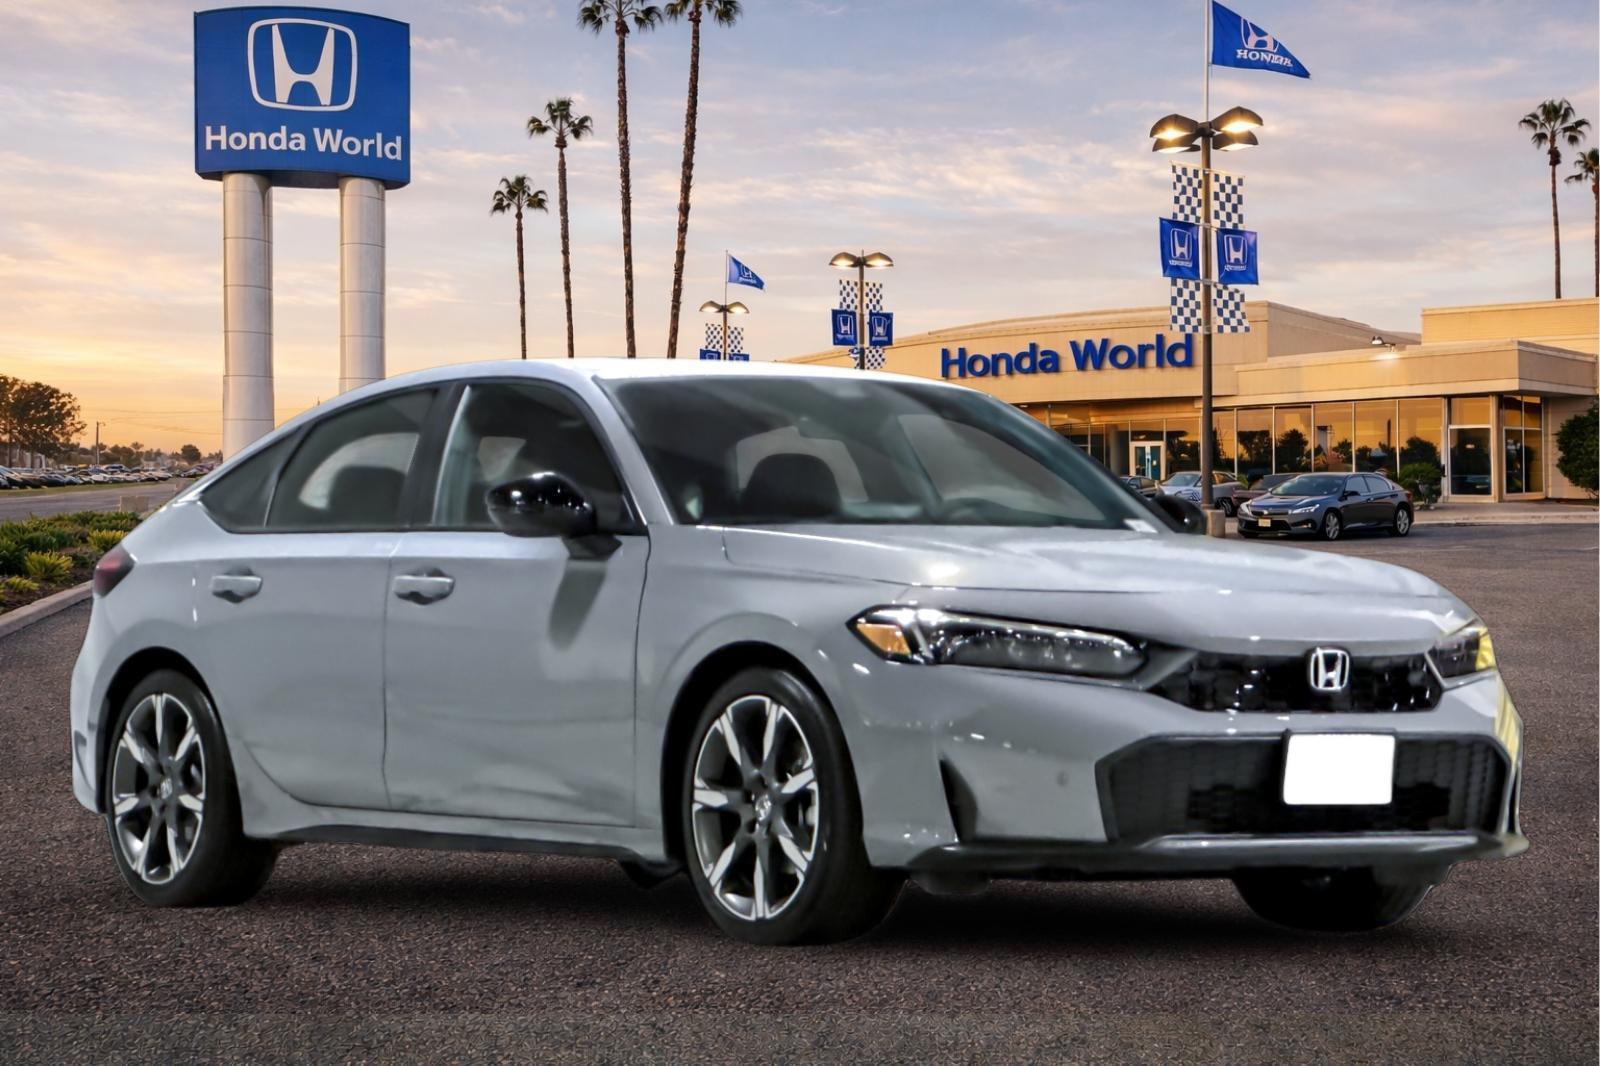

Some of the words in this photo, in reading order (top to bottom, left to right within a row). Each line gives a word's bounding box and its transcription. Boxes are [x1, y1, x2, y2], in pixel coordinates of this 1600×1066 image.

[205, 125, 306, 151] Honda
[312, 127, 402, 161] World
[941, 342, 1060, 378] Honda
[1069, 333, 1194, 371] World
